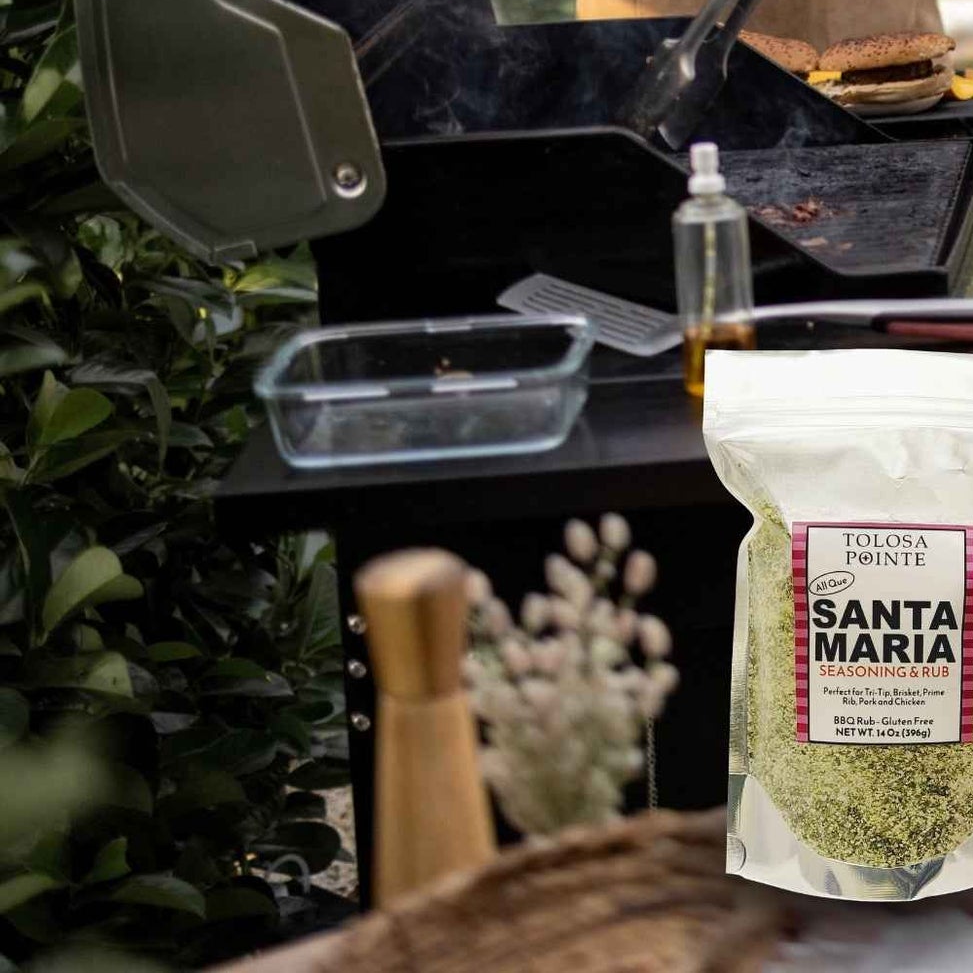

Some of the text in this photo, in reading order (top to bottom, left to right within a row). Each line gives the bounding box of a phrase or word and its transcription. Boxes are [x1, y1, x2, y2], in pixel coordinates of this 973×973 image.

[843, 533, 928, 548] TOLOSA
[845, 551, 926, 567] POINTE
[815, 577, 848, 592] All Que
[812, 599, 958, 630] SANTA
[815, 632, 956, 664] MARIA
[819, 665, 949, 678] SEASONING & RUB
[823, 687, 945, 698] Perfect for Tri-Tip, Brisket, Prime
[842, 697, 926, 706] Rib, Pork and Chicken
[834, 716, 855, 725] BBQ
[881, 717, 912, 726] Gluten
[914, 717, 934, 725] Free
[835, 728, 931, 738] NET WT. 14 Oz (396g)
